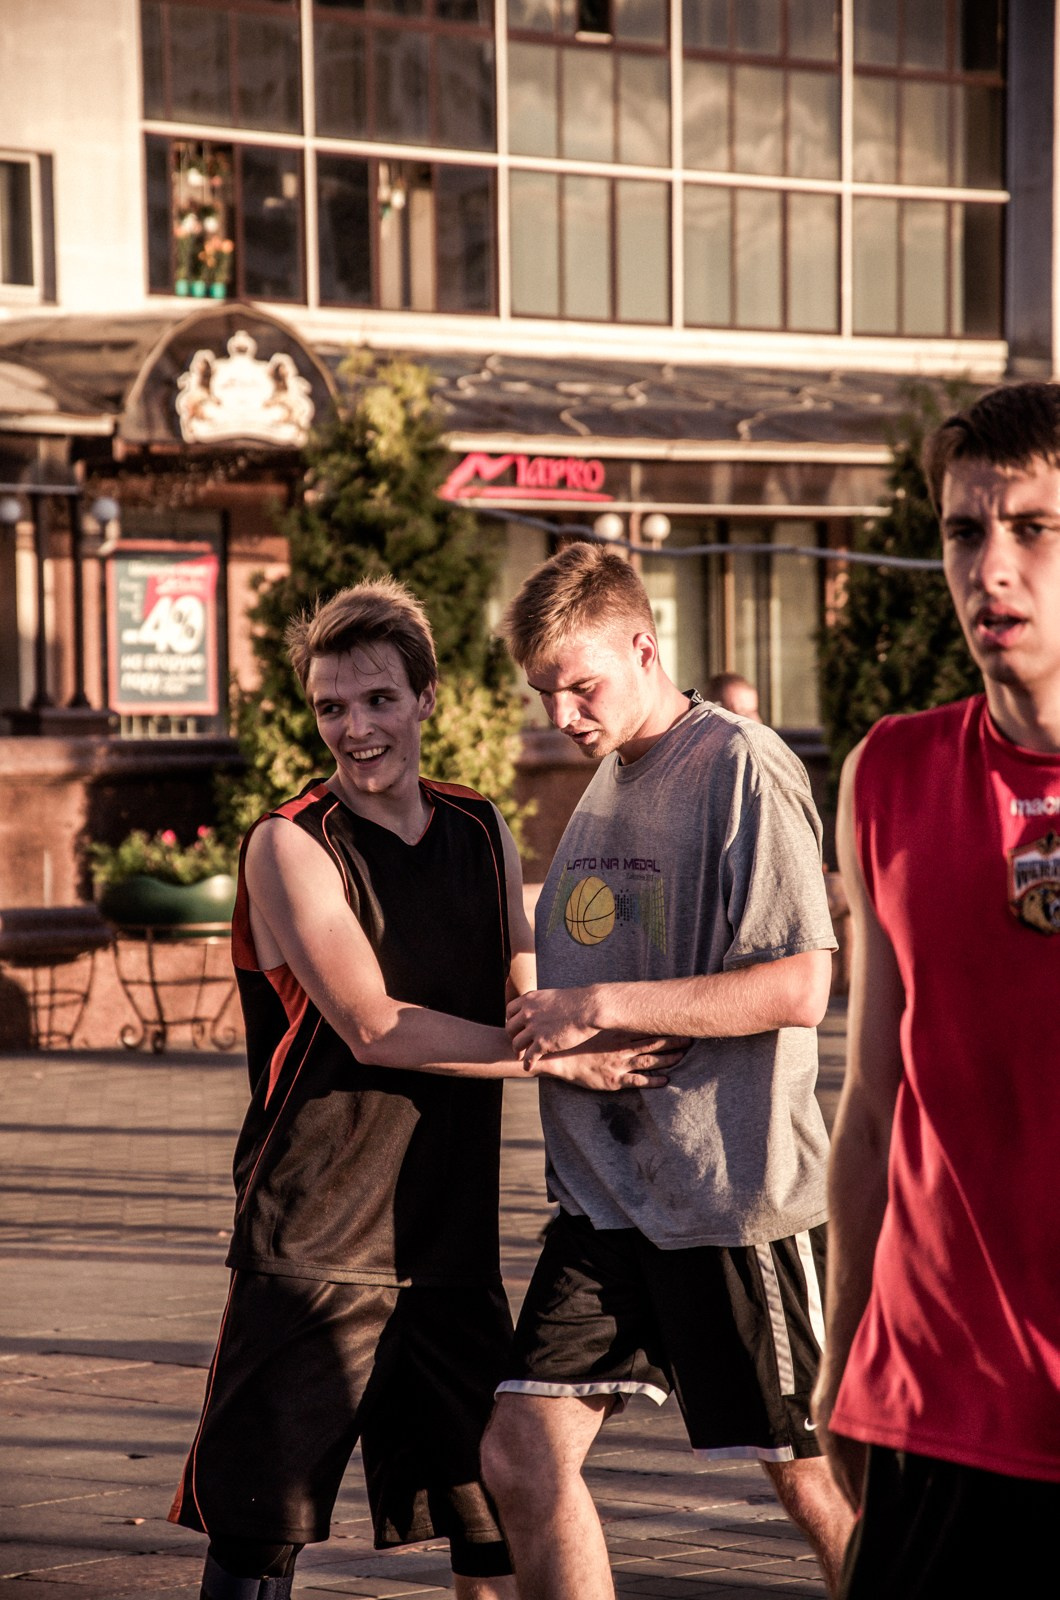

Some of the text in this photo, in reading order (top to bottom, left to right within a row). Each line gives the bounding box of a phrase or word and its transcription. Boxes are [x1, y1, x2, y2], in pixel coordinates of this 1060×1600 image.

[566, 858, 661, 873] LATO NA MEDAL
